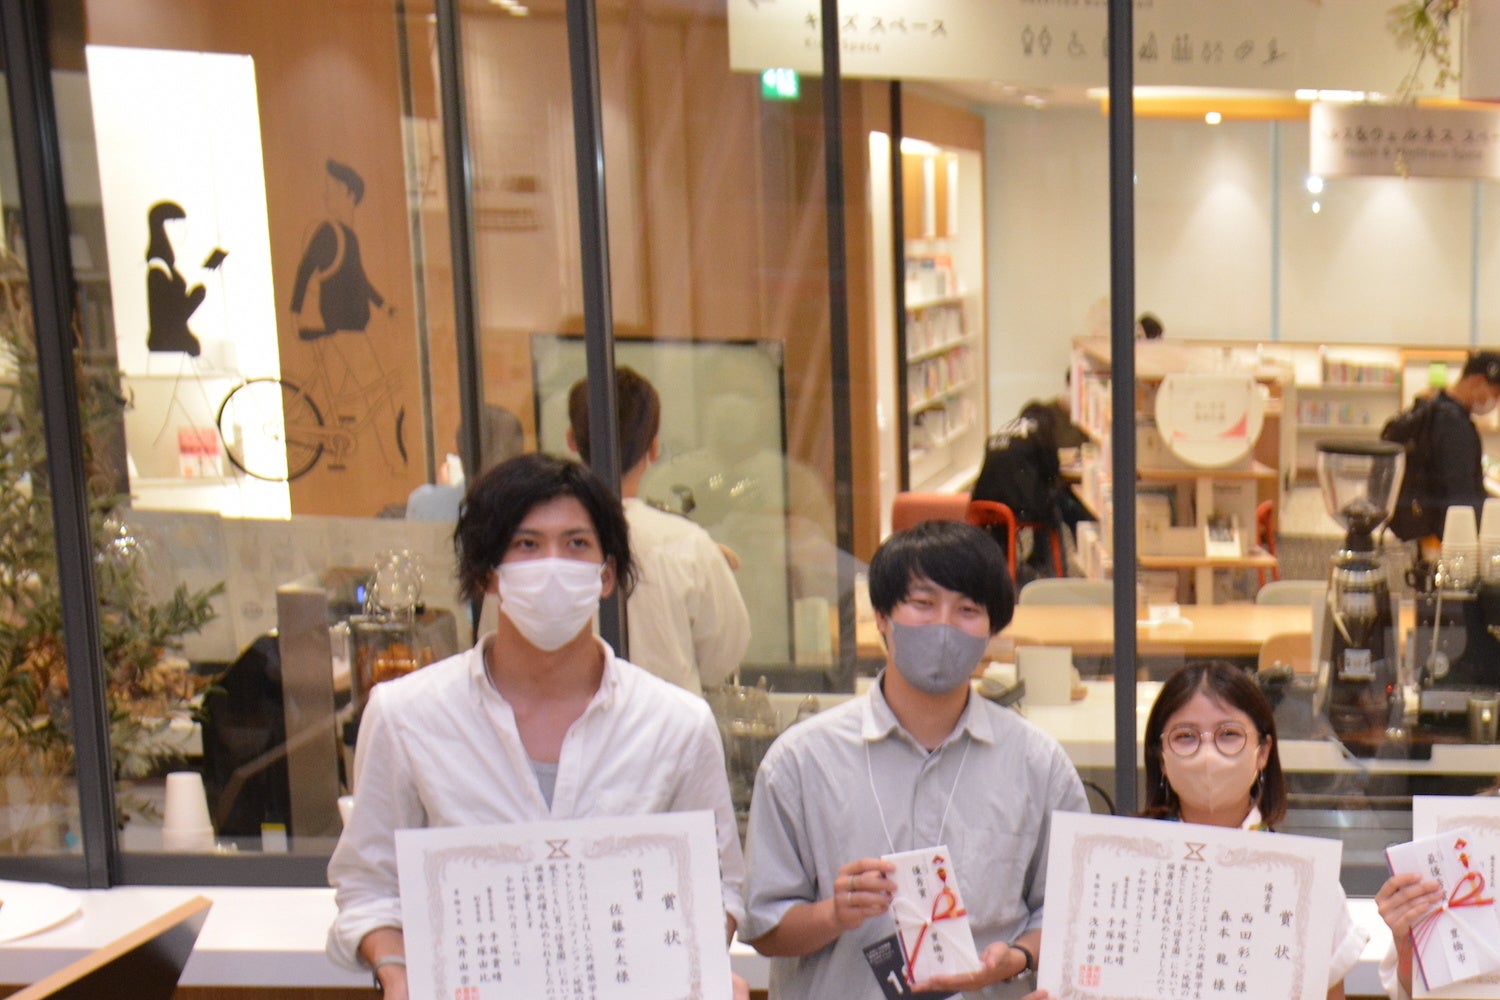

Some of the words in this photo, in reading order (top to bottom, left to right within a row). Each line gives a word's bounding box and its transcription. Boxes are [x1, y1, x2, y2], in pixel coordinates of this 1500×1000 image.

[661, 891, 681, 946] 賞状
[1261, 881, 1274, 913] 優秀賞
[1273, 909, 1295, 961] 賞状
